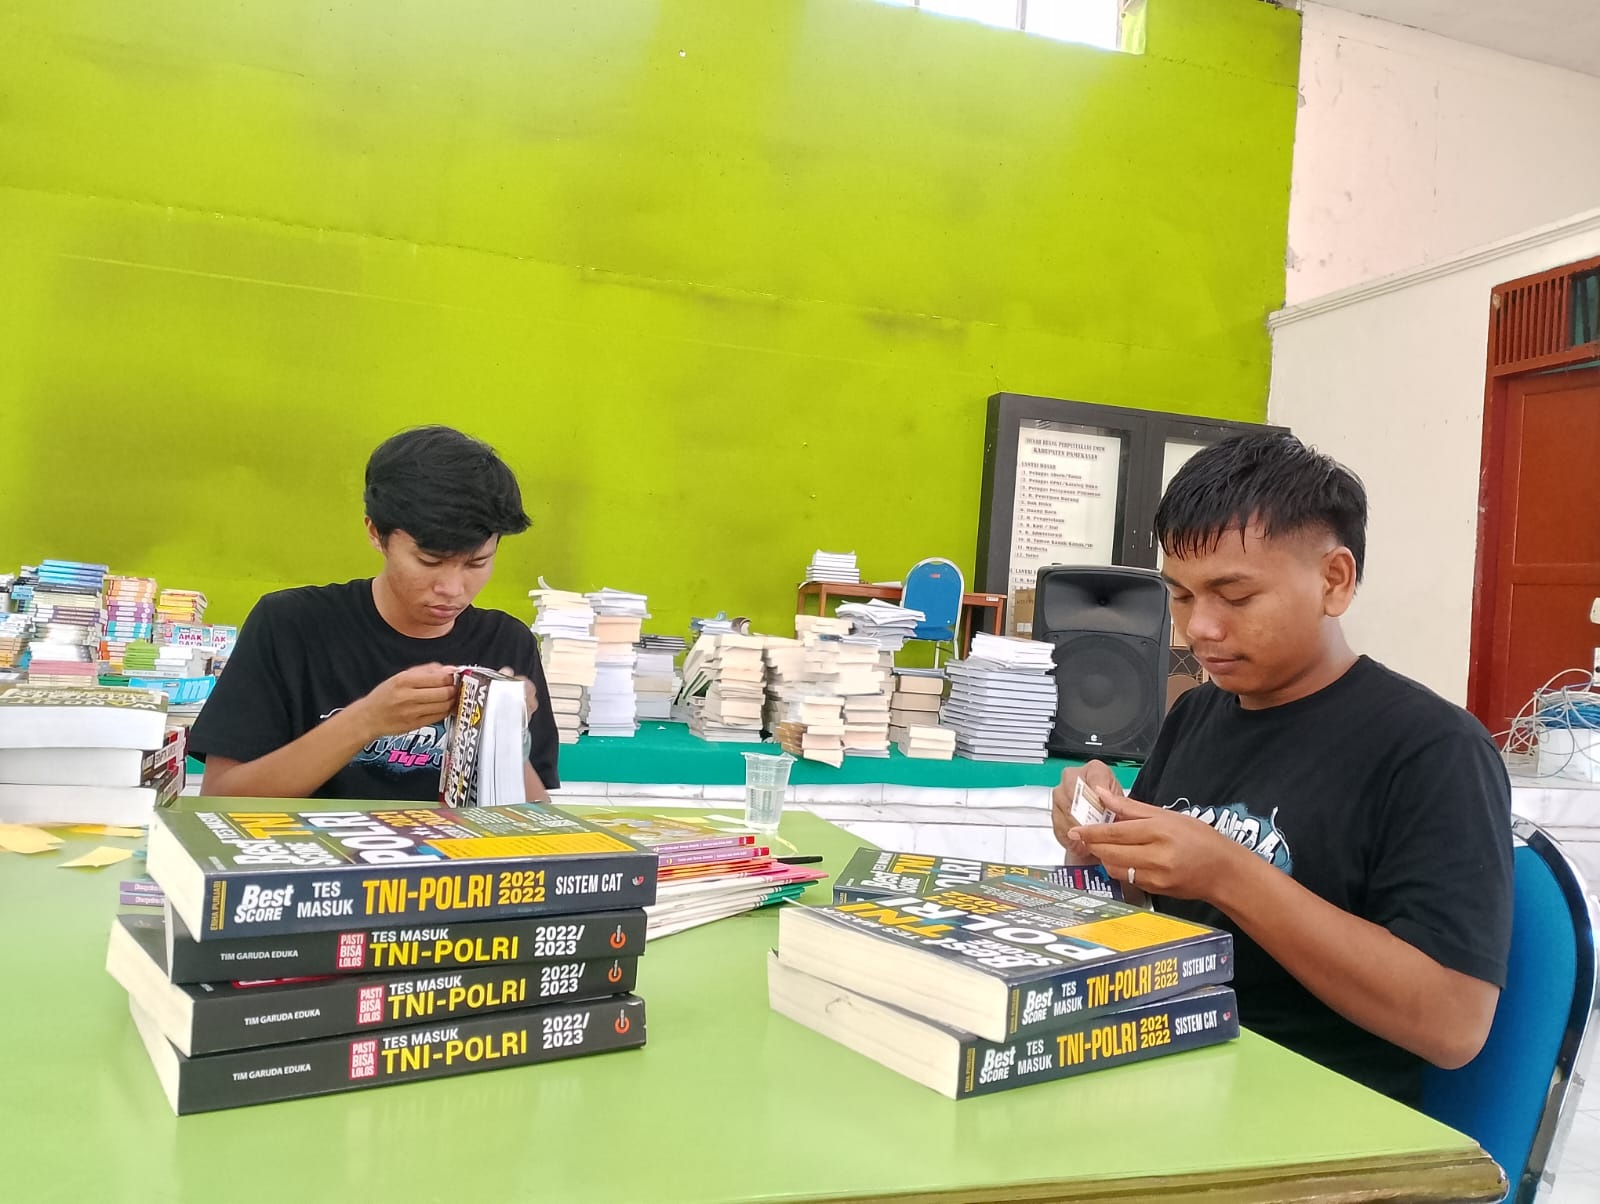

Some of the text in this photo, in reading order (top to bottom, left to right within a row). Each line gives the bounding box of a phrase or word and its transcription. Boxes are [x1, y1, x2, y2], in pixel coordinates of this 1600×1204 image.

[227, 812, 314, 839] TNI
[297, 811, 441, 864] POLRI
[499, 870, 546, 889] 2021
[555, 872, 624, 896] SISTEM CAT
[933, 858, 982, 891] OLRI
[242, 884, 295, 909] Best
[312, 881, 341, 899] TES
[362, 874, 493, 916] TNI-POLRI
[498, 887, 546, 906] 2022
[297, 899, 354, 919] MASUK
[835, 902, 955, 938] TNI
[875, 897, 1117, 961] POLRI
[340, 933, 364, 946] PASTI
[371, 928, 449, 943] TES MASUK
[535, 924, 586, 942] 2022/
[220, 950, 299, 961] TIM GARUDA EDUKA
[339, 945, 363, 957] BISA
[369, 936, 519, 968] TNI-POLRI
[533, 941, 577, 958] 2023
[338, 956, 362, 968] LOLOS
[1154, 957, 1178, 975] 2021
[1182, 954, 1217, 978] SISTEM CAT
[541, 962, 586, 982] 2022/
[1154, 972, 1179, 991] 2022
[360, 987, 382, 1000] PASTI
[389, 975, 462, 996] TES MASUK
[540, 978, 579, 997] 2023
[1061, 981, 1077, 997] TES
[1086, 965, 1152, 1009] TNI-POLRI
[360, 999, 381, 1012] BISA
[387, 978, 526, 1020] TNI-POLRI
[1026, 987, 1053, 1010] Best
[1053, 996, 1083, 1017] MASUK
[244, 1009, 321, 1026] TIM GARUDA EDUKA
[358, 1011, 381, 1023] LOLOS
[542, 1012, 590, 1034] 2022/
[1139, 1014, 1169, 1032] 2021
[1175, 1010, 1218, 1036] SISTEM CAT
[352, 1040, 376, 1054] PASTI
[383, 1028, 459, 1050] TES MASUK
[542, 1029, 584, 1049] 2023
[1026, 1040, 1044, 1057] TES
[1056, 1023, 1137, 1068] TNI-POLRI
[1140, 1030, 1171, 1049] 2022
[352, 1053, 375, 1067] BISA
[381, 1030, 527, 1075] TNI-POLRI
[984, 1046, 1015, 1071] Best
[232, 1063, 311, 1081] TIM GARUDA EDUKA
[350, 1066, 375, 1079] LOLOS
[1017, 1053, 1053, 1076] MASUK
